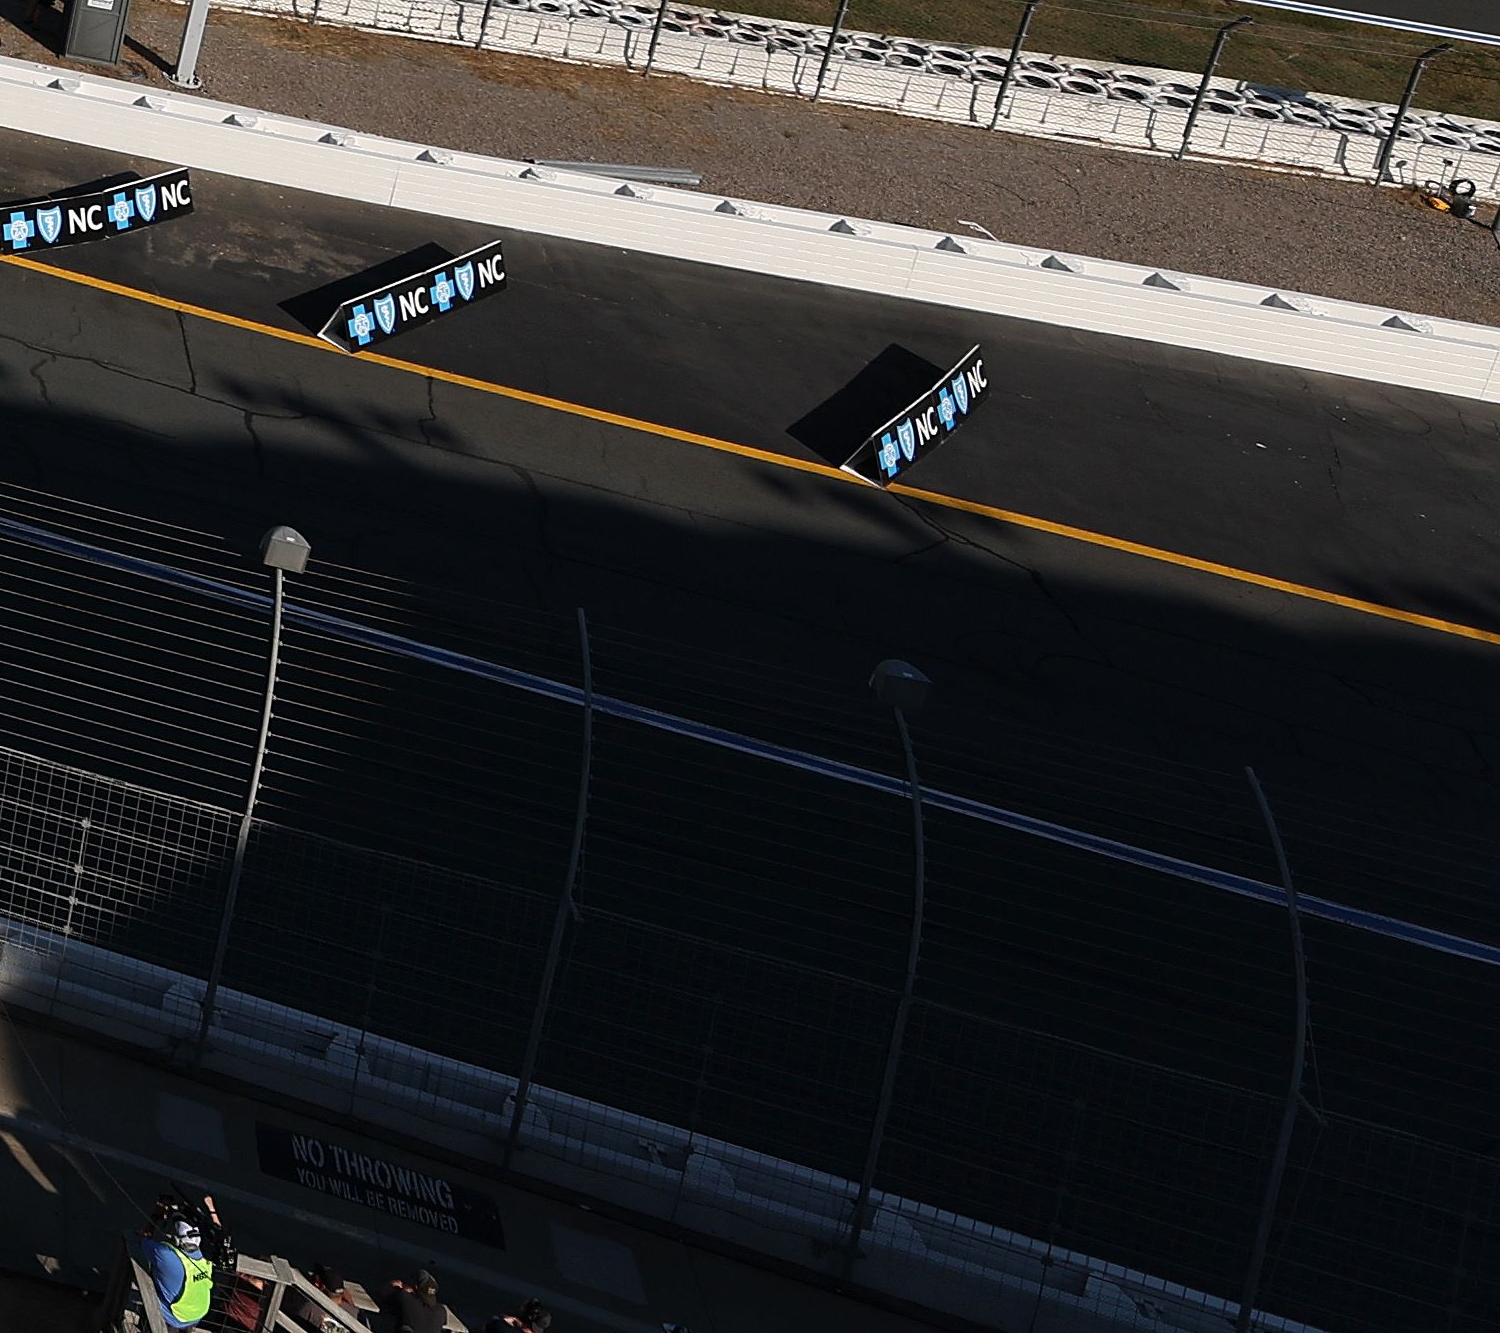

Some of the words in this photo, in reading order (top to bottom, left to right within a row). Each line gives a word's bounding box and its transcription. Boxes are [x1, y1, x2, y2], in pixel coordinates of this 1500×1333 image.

[66, 201, 104, 235] NC
[160, 178, 192, 212] NC
[399, 287, 429, 323] NC
[478, 254, 506, 288] NC
[916, 409, 939, 447] NC
[968, 358, 989, 396] NC
[292, 1134, 325, 1167] NO
[328, 1144, 455, 1209] THROWING
[296, 1168, 326, 1191] YOU
[325, 1176, 364, 1204] WILL
[366, 1189, 385, 1209] BE
[389, 1196, 459, 1234] REMOVED
